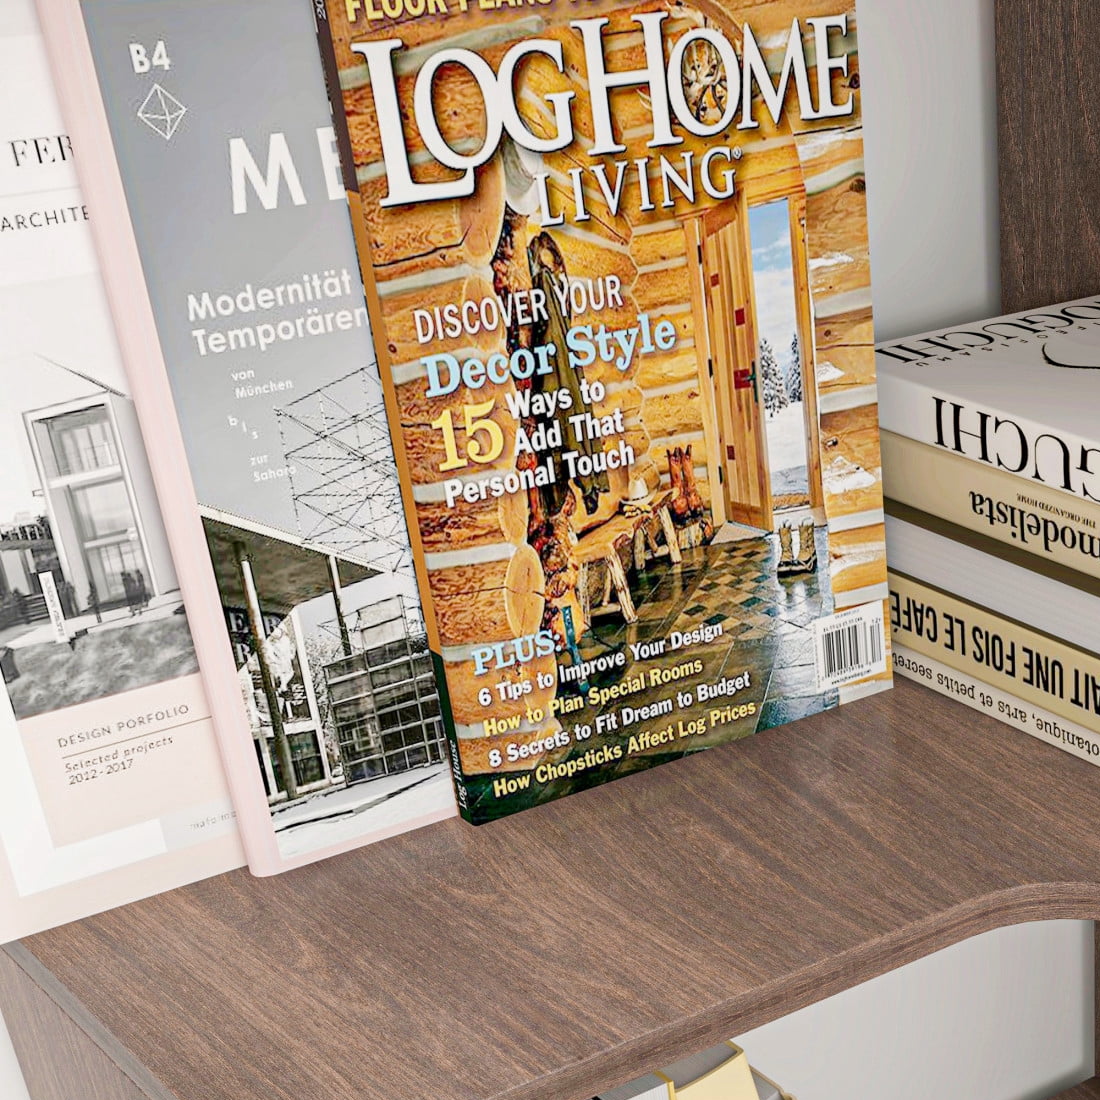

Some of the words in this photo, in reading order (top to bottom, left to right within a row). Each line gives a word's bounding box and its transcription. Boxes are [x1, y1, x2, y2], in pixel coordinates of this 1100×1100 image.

[129, 40, 171, 74] B4
[0, 205, 89, 232] ARCHITE
[186, 269, 352, 322] Modernität
[413, 288, 549, 344] DISCOVER
[552, 275, 623, 318] YOUR
[192, 304, 370, 356] Temporären
[420, 341, 557, 398] Decor
[566, 313, 677, 371] Style
[231, 369, 255, 381] von
[505, 386, 572, 420] Ways
[580, 378, 605, 404] to
[432, 398, 504, 472] 15
[513, 420, 562, 457] Add
[568, 408, 625, 443] That
[443, 456, 556, 508] Personal
[563, 440, 635, 478] Touch
[890, 590, 937, 643] CAFÉ
[943, 612, 966, 656] LE
[471, 628, 563, 677] PLUS:
[478, 687, 493, 707] 6
[495, 675, 533, 704] Tips
[536, 671, 554, 691] to
[558, 651, 626, 686] Improve
[628, 637, 666, 662] Your
[670, 621, 724, 654] Design
[972, 625, 1016, 678] FOIS
[1023, 647, 1064, 698] UNE
[482, 713, 521, 738] How
[525, 706, 544, 725] to
[547, 695, 584, 719] Plan
[588, 674, 647, 709] Special
[650, 657, 704, 688] Rooms
[937, 672, 976, 701] petits
[978, 690, 994, 707] et
[998, 699, 1027, 723] arts
[57, 726, 112, 748] DESIGN
[117, 704, 189, 732] PORFOLIO
[488, 749, 502, 769] 8
[506, 730, 571, 763] Secrets
[574, 722, 593, 741] to
[595, 713, 618, 735] Fit
[621, 699, 674, 728] Dream
[676, 691, 693, 709] to
[696, 671, 751, 705] Budget
[65, 750, 118, 773] Selected
[493, 774, 531, 800] How
[535, 744, 623, 786] Chopsticks
[627, 726, 674, 756] Affect
[678, 715, 706, 738] Log
[709, 700, 756, 728] Prices
